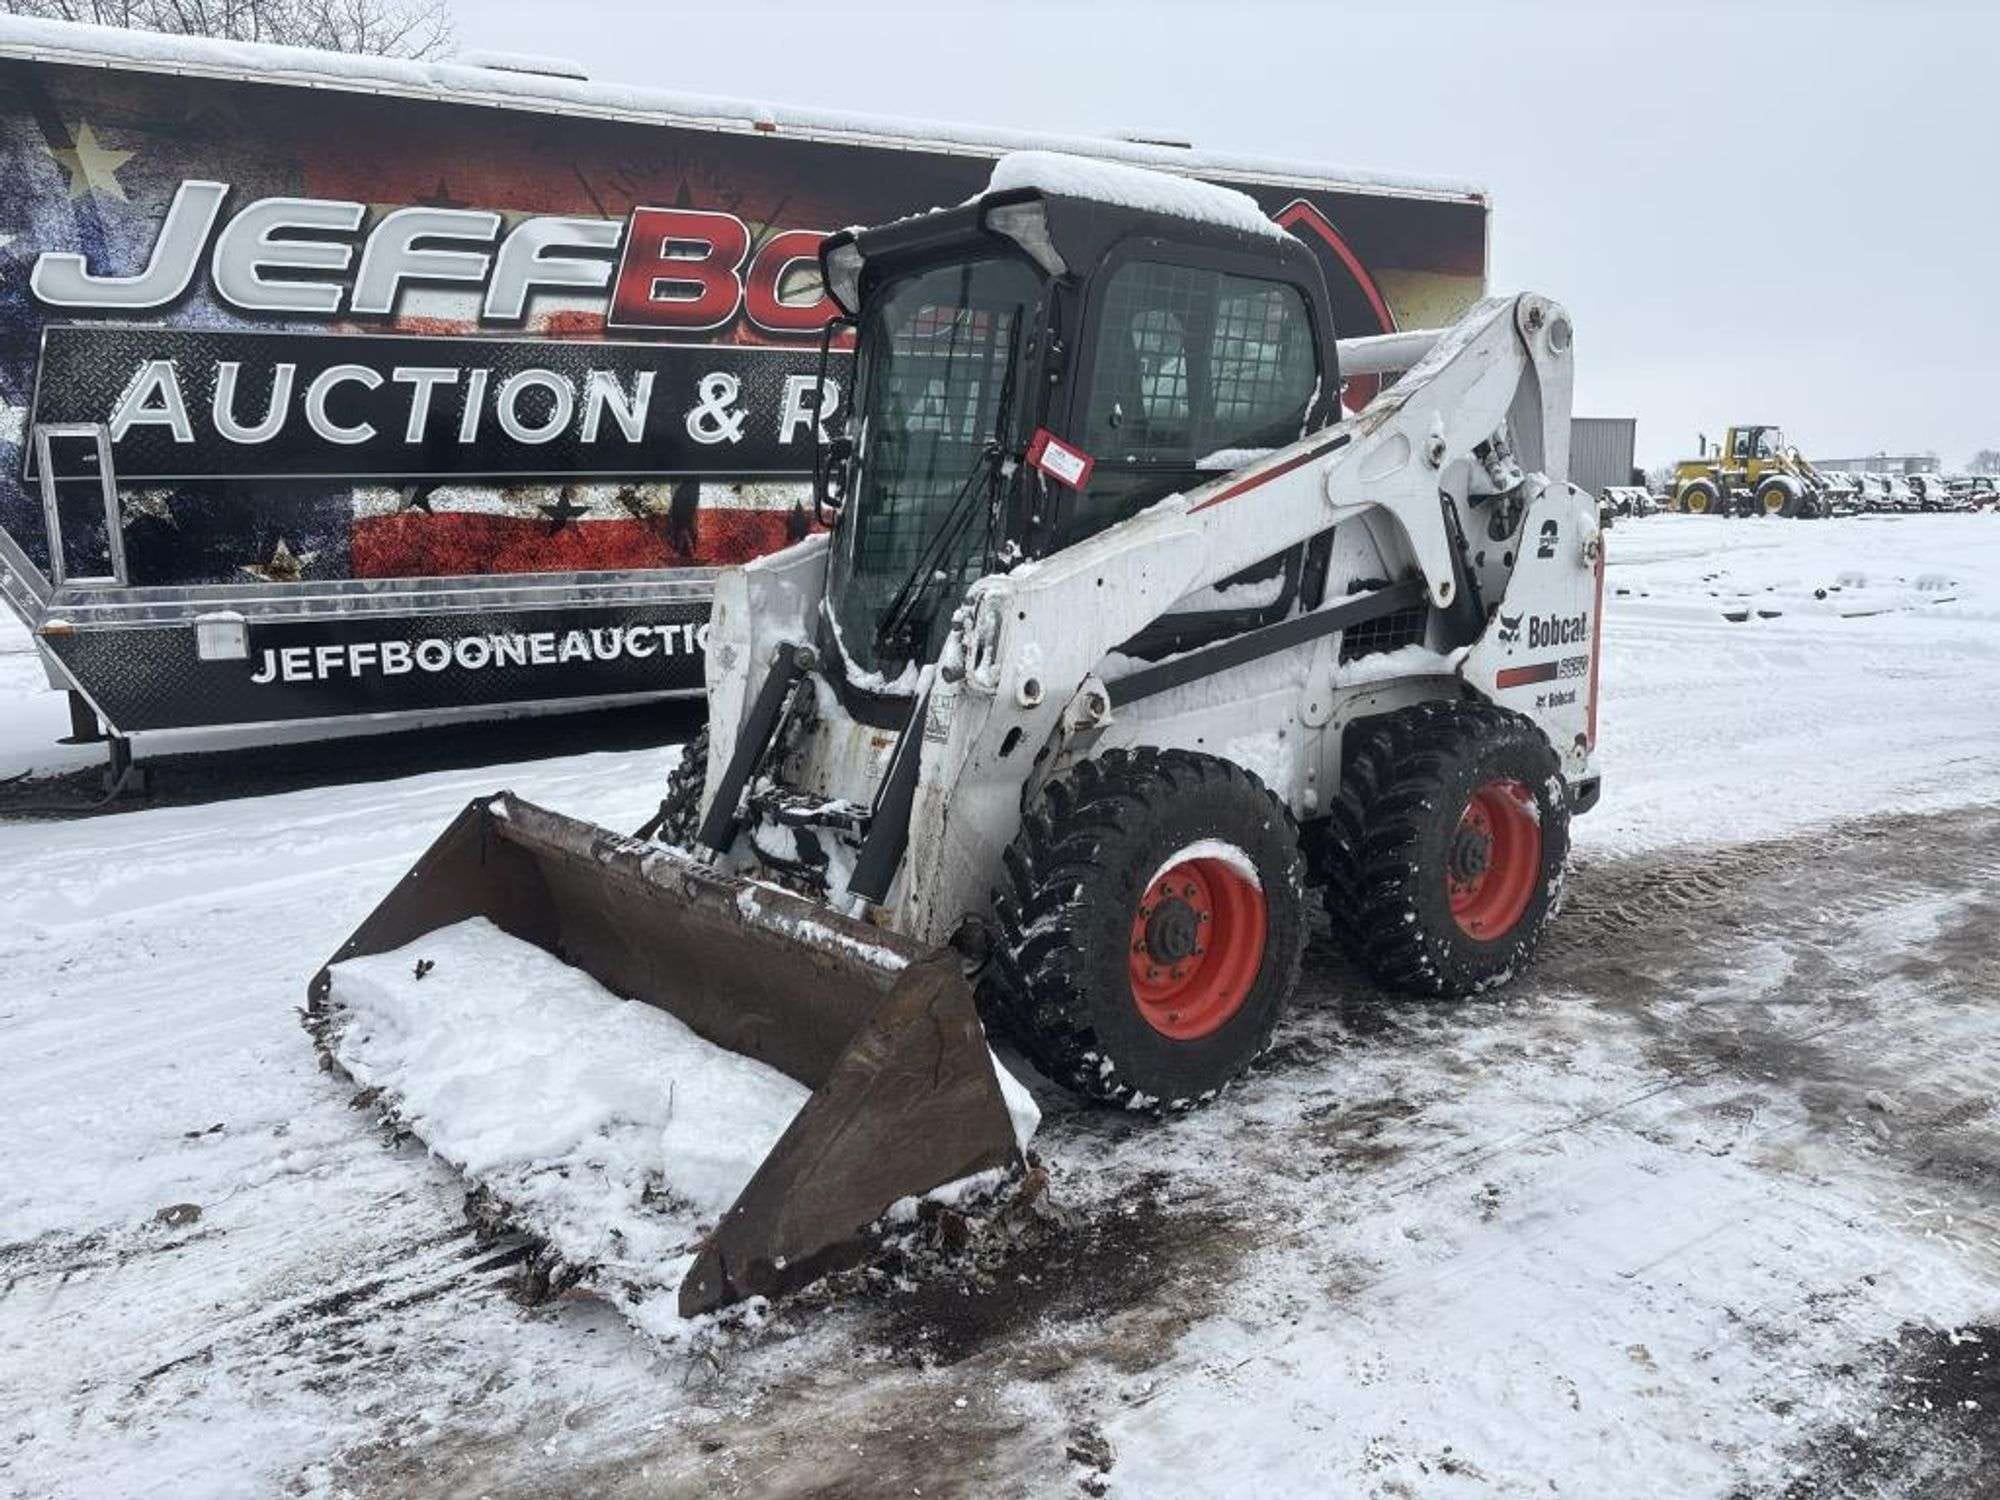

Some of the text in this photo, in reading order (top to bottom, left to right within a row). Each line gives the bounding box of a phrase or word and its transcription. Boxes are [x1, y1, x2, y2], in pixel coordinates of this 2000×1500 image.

[110, 359, 656, 445] AUCTION
[686, 373, 746, 445] &
[1529, 611, 1588, 649] Bobcat
